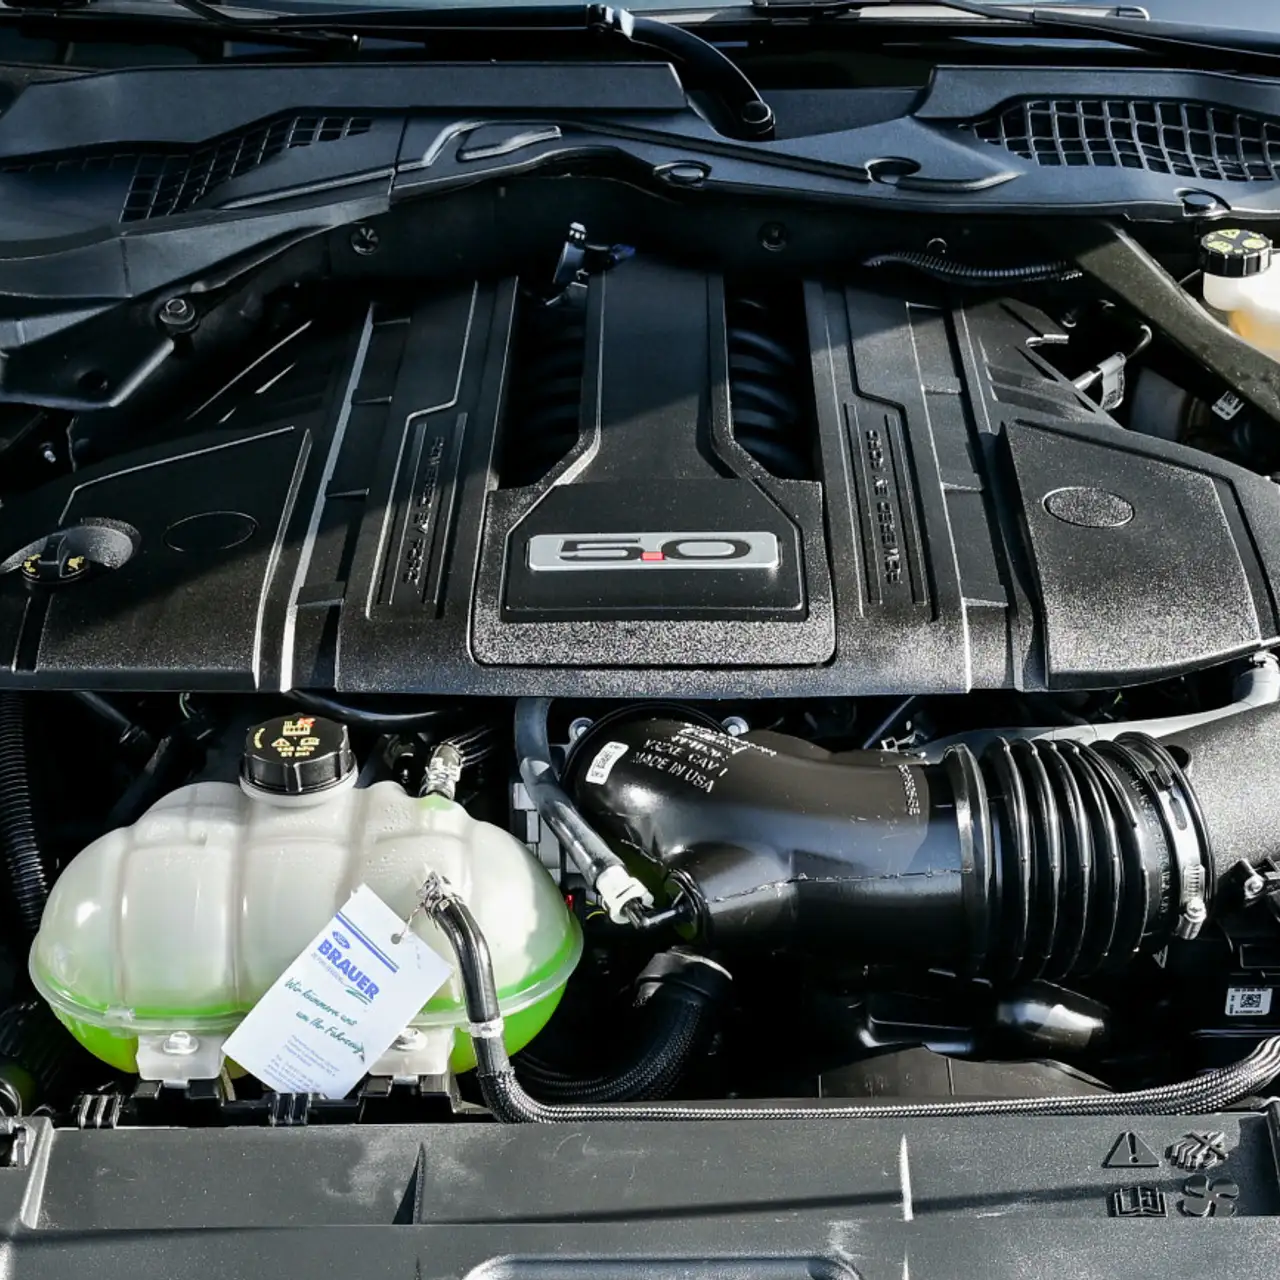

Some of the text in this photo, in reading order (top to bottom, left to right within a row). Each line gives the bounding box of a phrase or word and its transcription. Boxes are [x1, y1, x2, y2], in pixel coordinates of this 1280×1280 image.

[558, 537, 752, 561] 5.0
[685, 769, 715, 793] USA
[317, 938, 380, 1000] BRAUER
